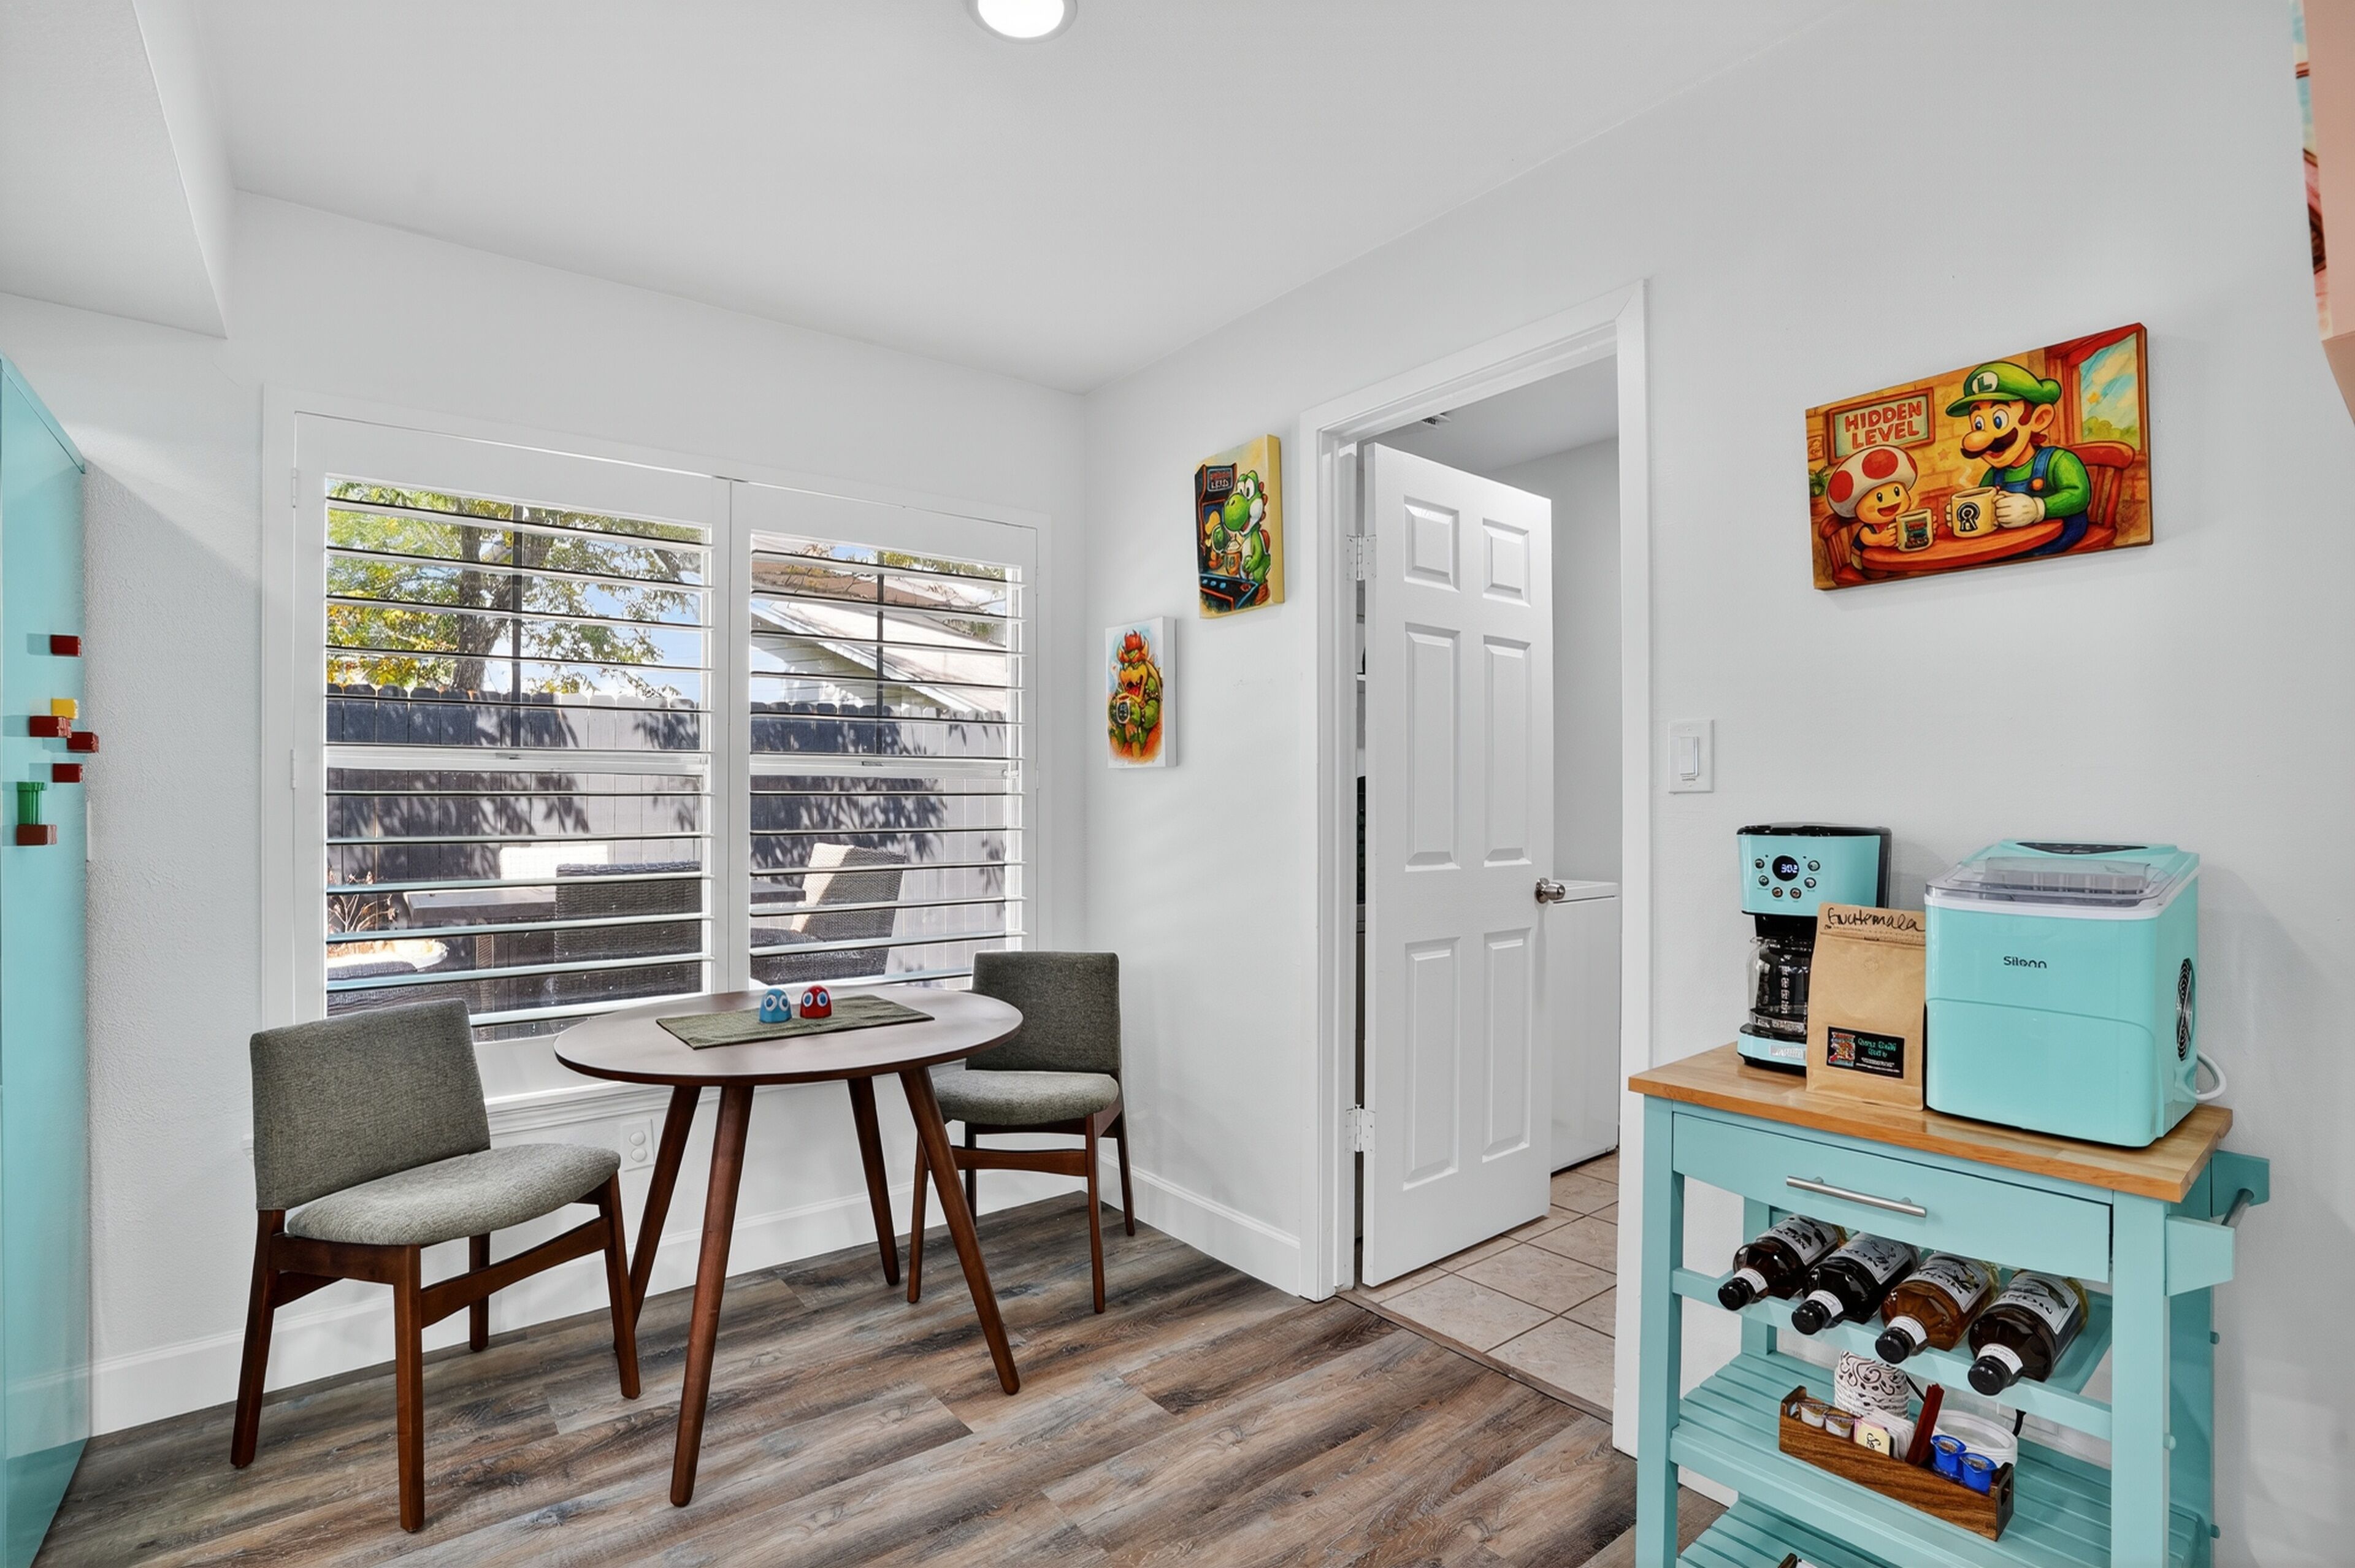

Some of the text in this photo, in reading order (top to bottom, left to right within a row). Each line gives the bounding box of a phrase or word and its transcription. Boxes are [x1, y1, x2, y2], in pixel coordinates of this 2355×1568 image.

[1977, 375, 1993, 392] L
[1845, 401, 1921, 432] HIDDEN
[1852, 421, 1920, 449] LEVEL
[2004, 955, 2047, 969] Silonn
